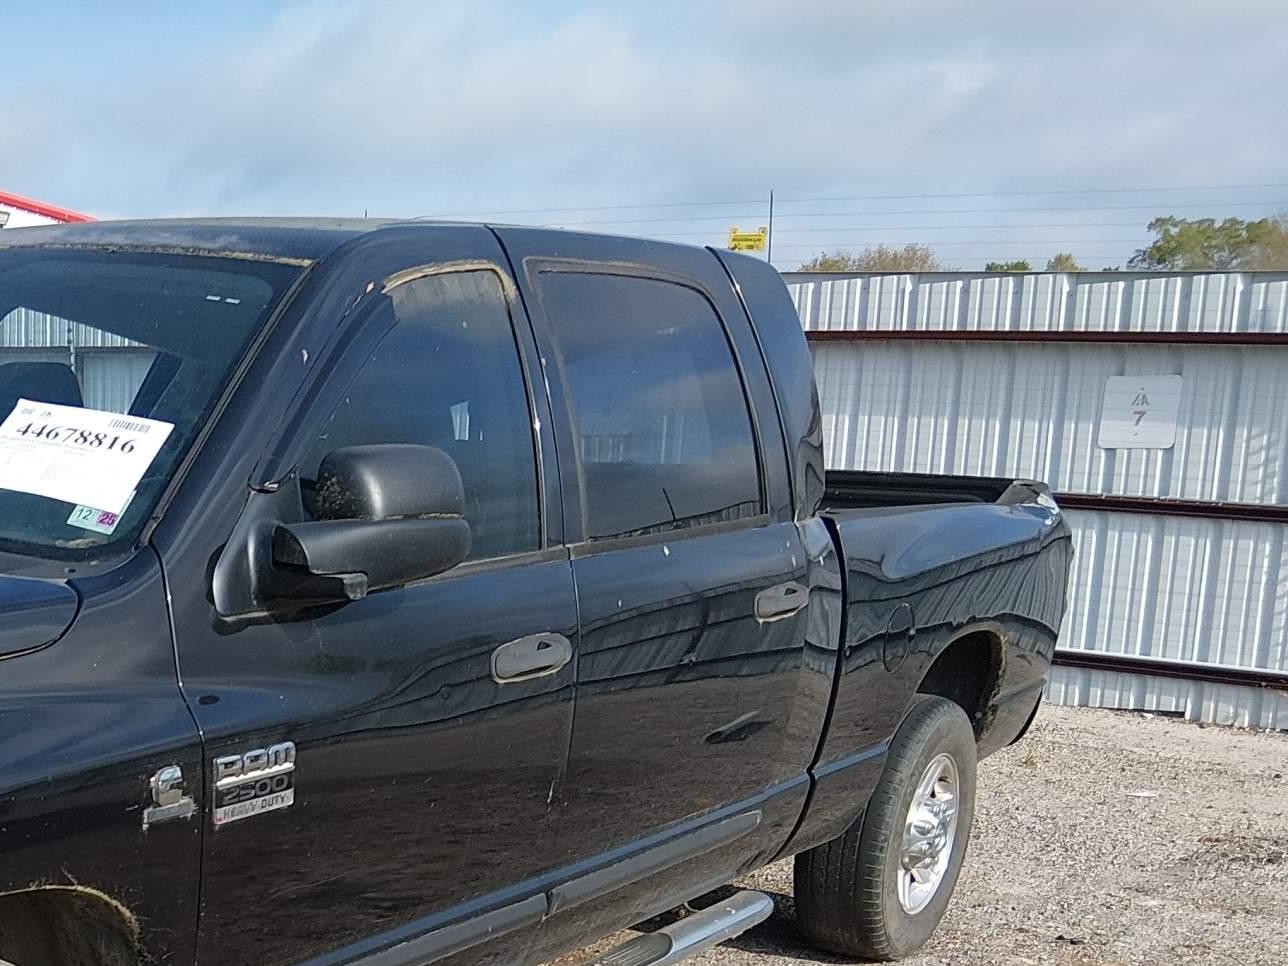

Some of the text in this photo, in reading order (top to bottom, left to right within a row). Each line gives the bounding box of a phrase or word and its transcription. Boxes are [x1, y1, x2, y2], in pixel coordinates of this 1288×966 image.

[1133, 410, 1147, 426] 7
[16, 421, 139, 454] 44678816
[76, 507, 115, 527] 12 25
[216, 741, 296, 778] RAM
[223, 776, 288, 804] 2500
[261, 794, 286, 808] DUTY
